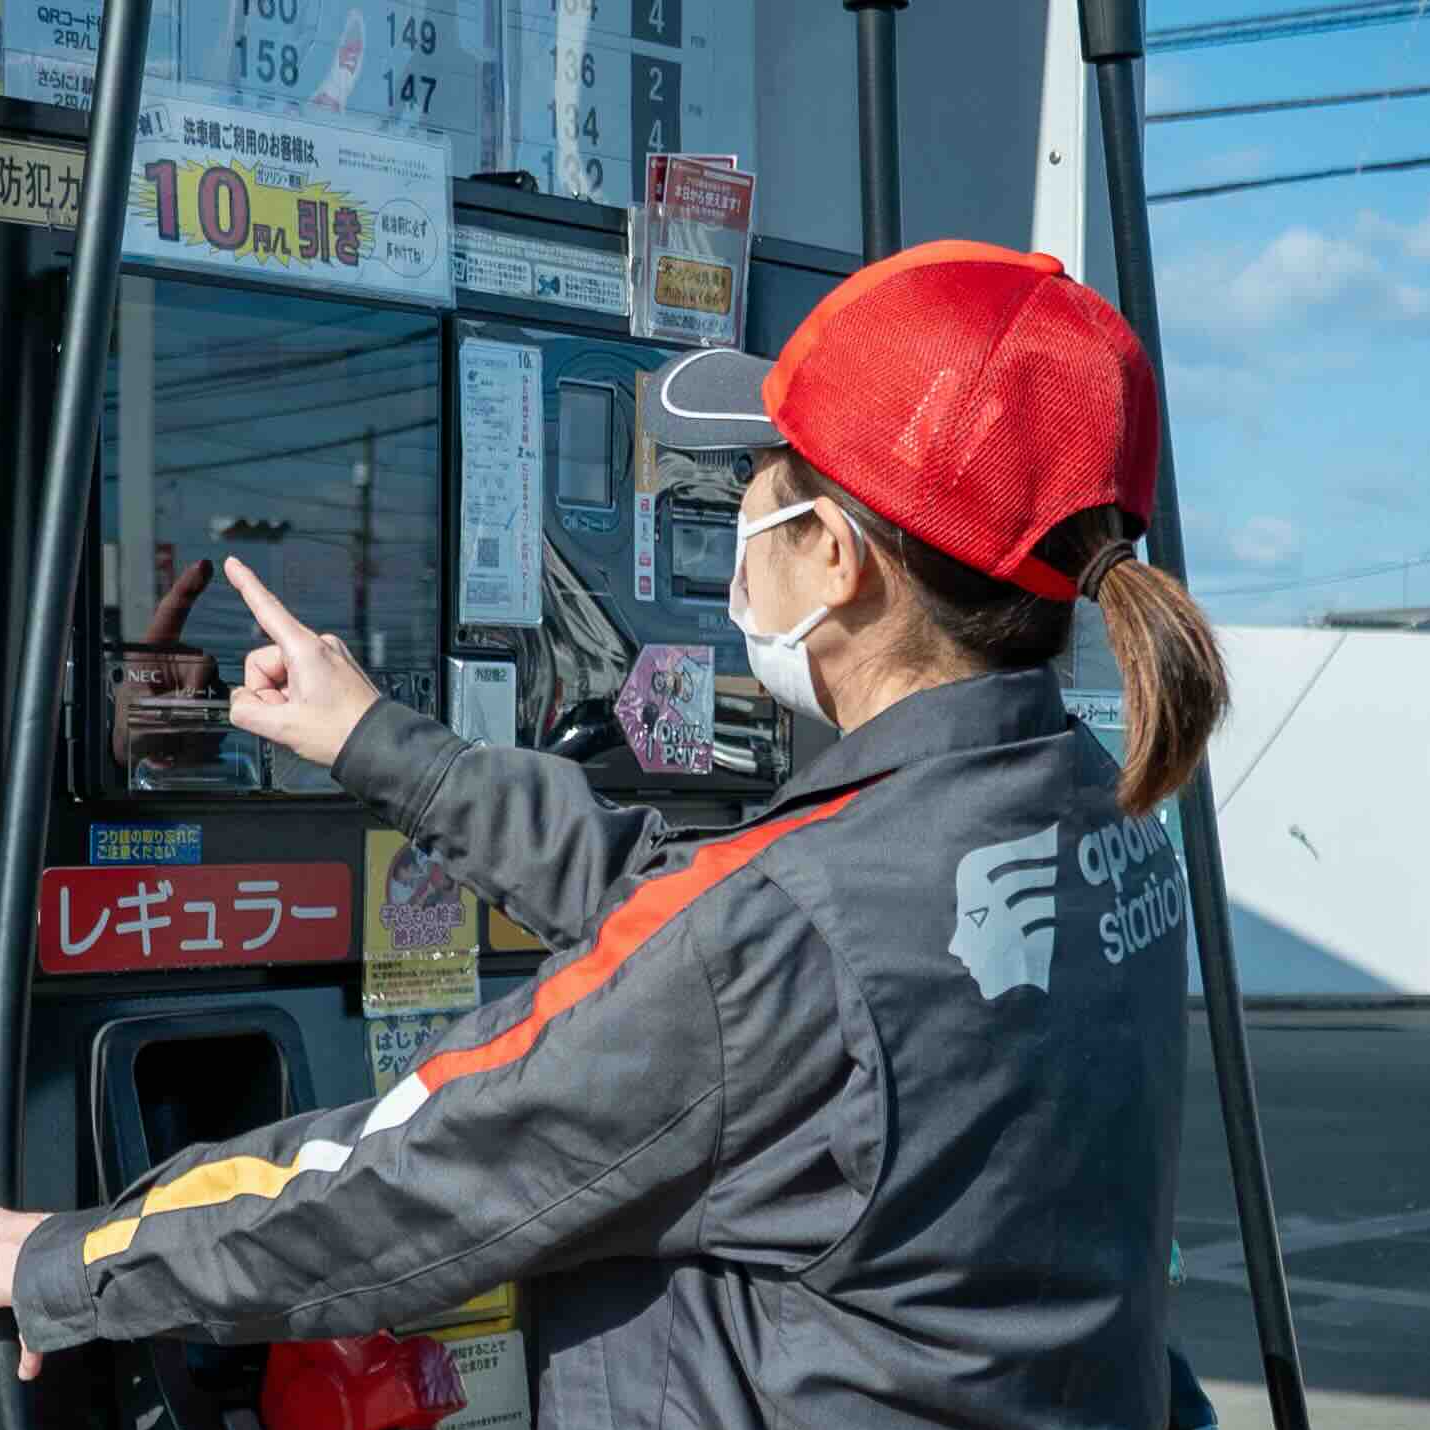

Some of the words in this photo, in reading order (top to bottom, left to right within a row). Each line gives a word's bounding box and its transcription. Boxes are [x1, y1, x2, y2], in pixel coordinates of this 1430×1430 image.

[386, 10, 437, 55] 149
[234, 35, 299, 88] 158
[649, 66, 664, 102] 2
[383, 68, 437, 114] 147
[127, 669, 163, 684] NEC
[59, 880, 338, 957] レギュラー
